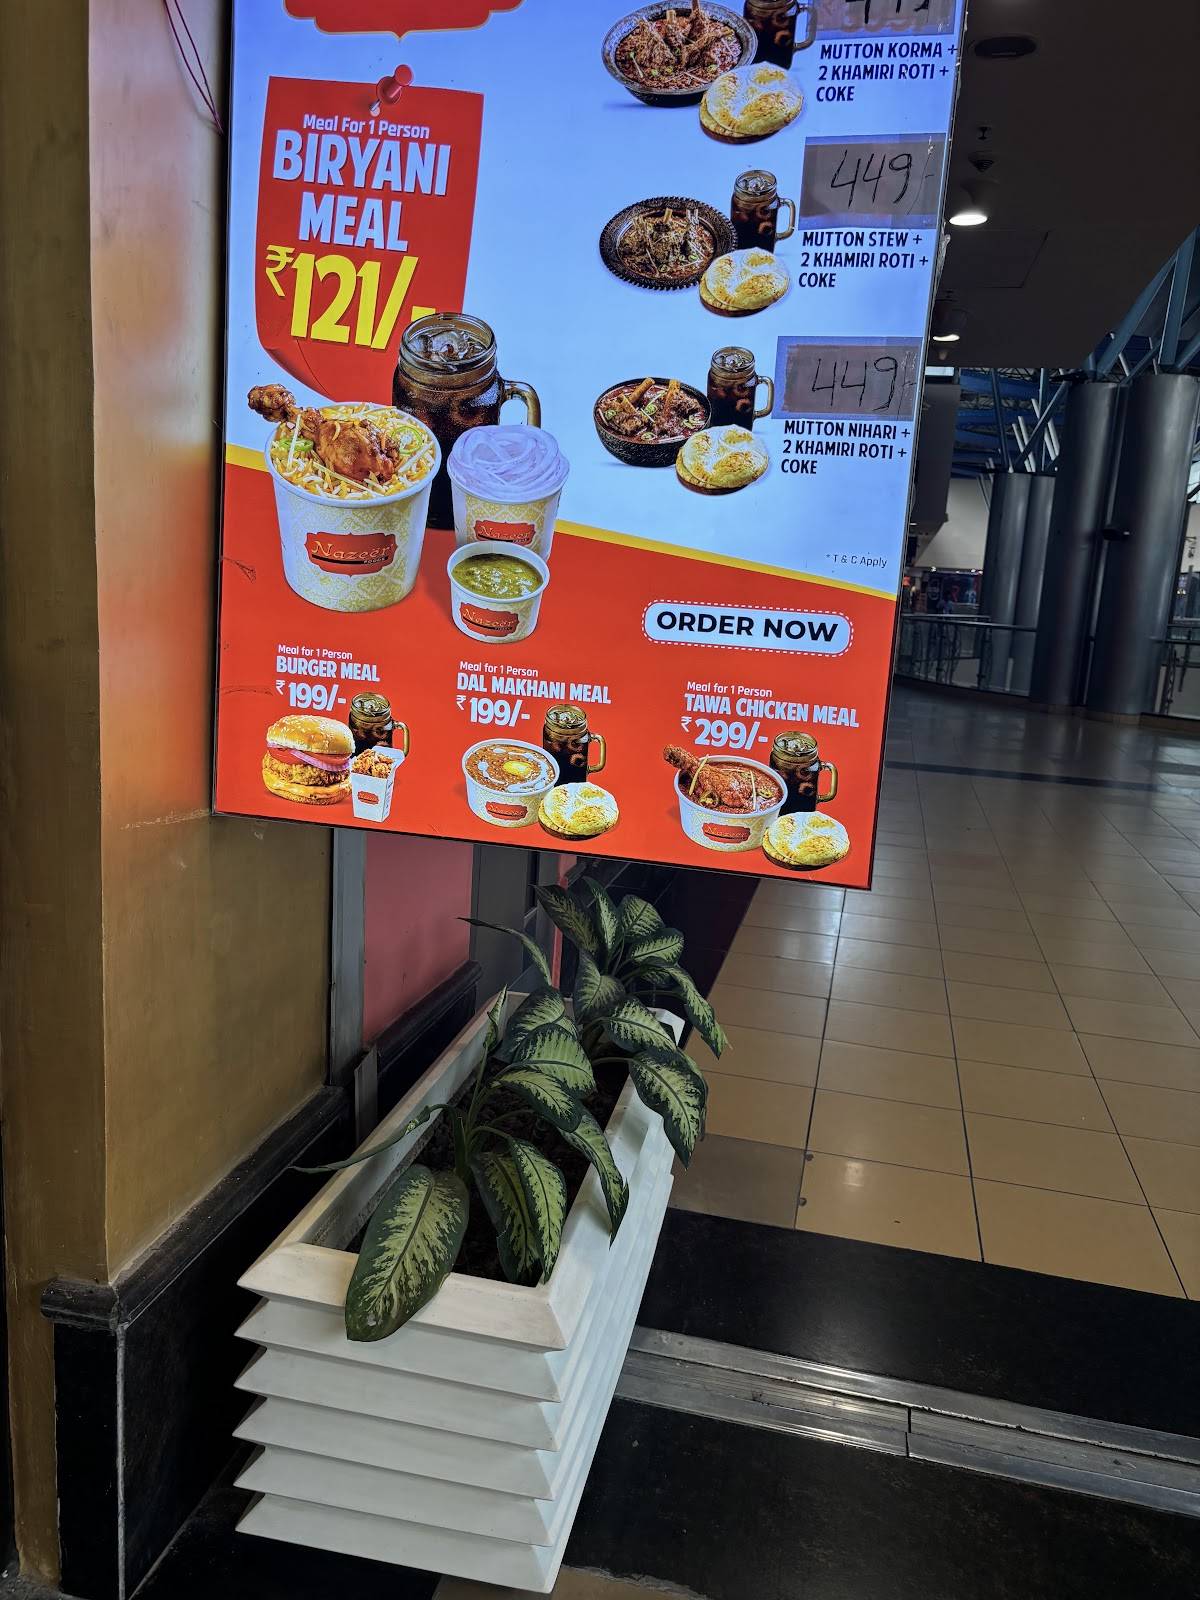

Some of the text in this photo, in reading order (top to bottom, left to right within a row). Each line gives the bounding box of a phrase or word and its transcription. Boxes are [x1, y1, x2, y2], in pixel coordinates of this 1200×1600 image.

[820, 42, 958, 59] MUTTON KORMA +
[818, 63, 949, 81] 2 KHAMIRI ROTI +
[816, 86, 855, 102] COKE
[303, 114, 430, 139] Meal For 1 Person
[272, 129, 452, 197] BIRYANI
[298, 191, 409, 253] MEAL
[802, 231, 923, 247] MUTTON STEW +
[800, 252, 929, 269] 2 KHAMIRI ROTI +
[798, 272, 837, 288] COKE
[784, 420, 911, 440] MUTTON NIHARI +
[782, 440, 907, 459] 2 KHAMIRI ROTI +
[781, 458, 818, 474] COKE
[840, 554, 848, 564] &
[850, 555, 858, 564] C
[860, 556, 888, 569] Apply
[656, 611, 839, 642] ORDER NOW
[278, 644, 353, 660] Meal for 1 Person
[276, 655, 380, 682] BURGER MEAL
[459, 661, 539, 677] Meal for 1 Person
[457, 672, 612, 705] DAL MAKHANI MEAL
[687, 681, 773, 698] Meal for 1 Person
[684, 693, 860, 729] TAWA CHICKEN MEAL
